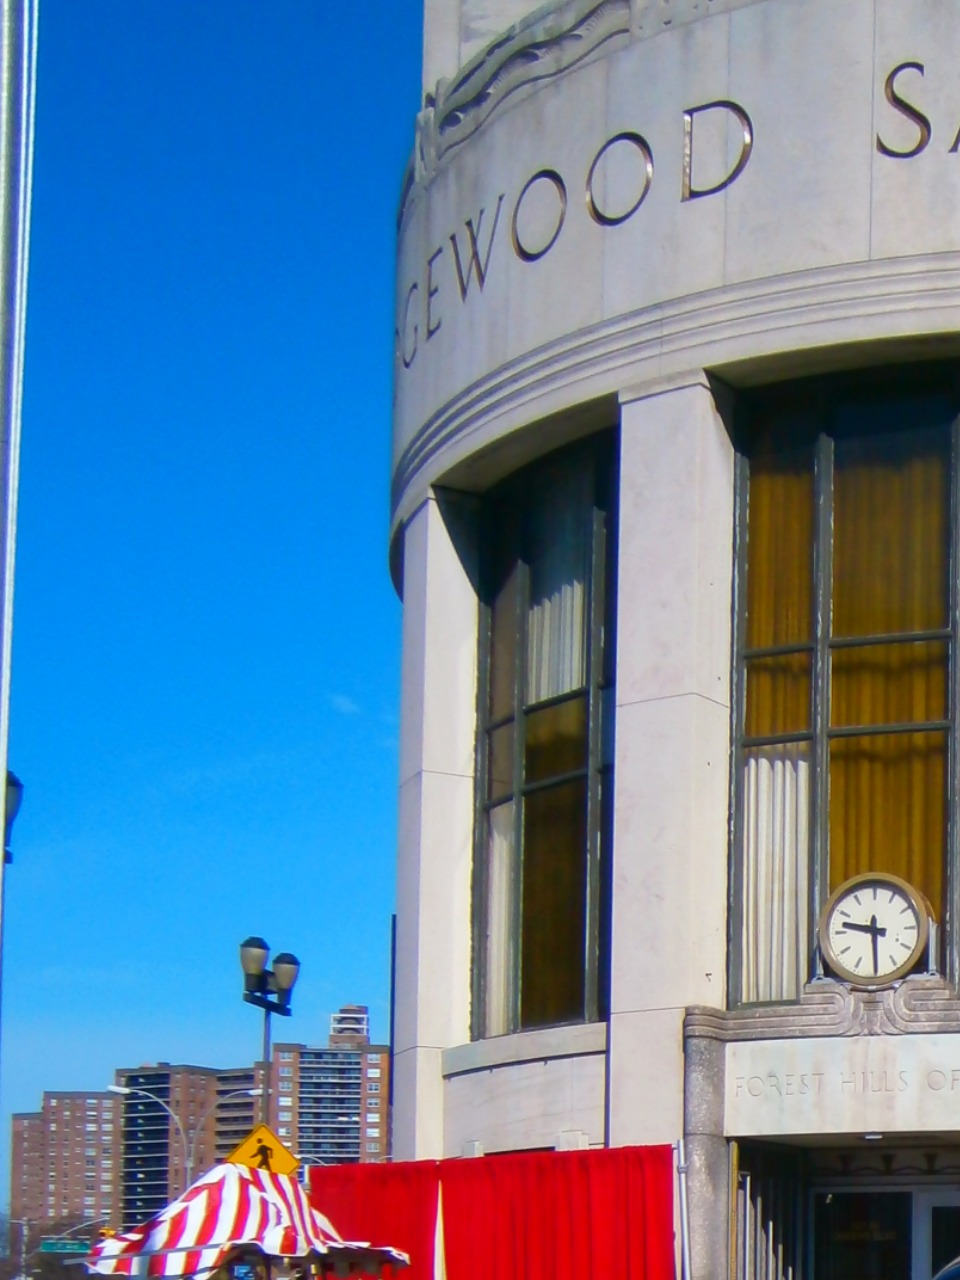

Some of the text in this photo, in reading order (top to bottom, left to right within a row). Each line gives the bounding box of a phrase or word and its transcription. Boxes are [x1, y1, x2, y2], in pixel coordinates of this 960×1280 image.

[395, 100, 753, 370] GEWOOD
[735, 1072, 825, 1098] FOREST
[840, 1070, 907, 1093] HILLS
